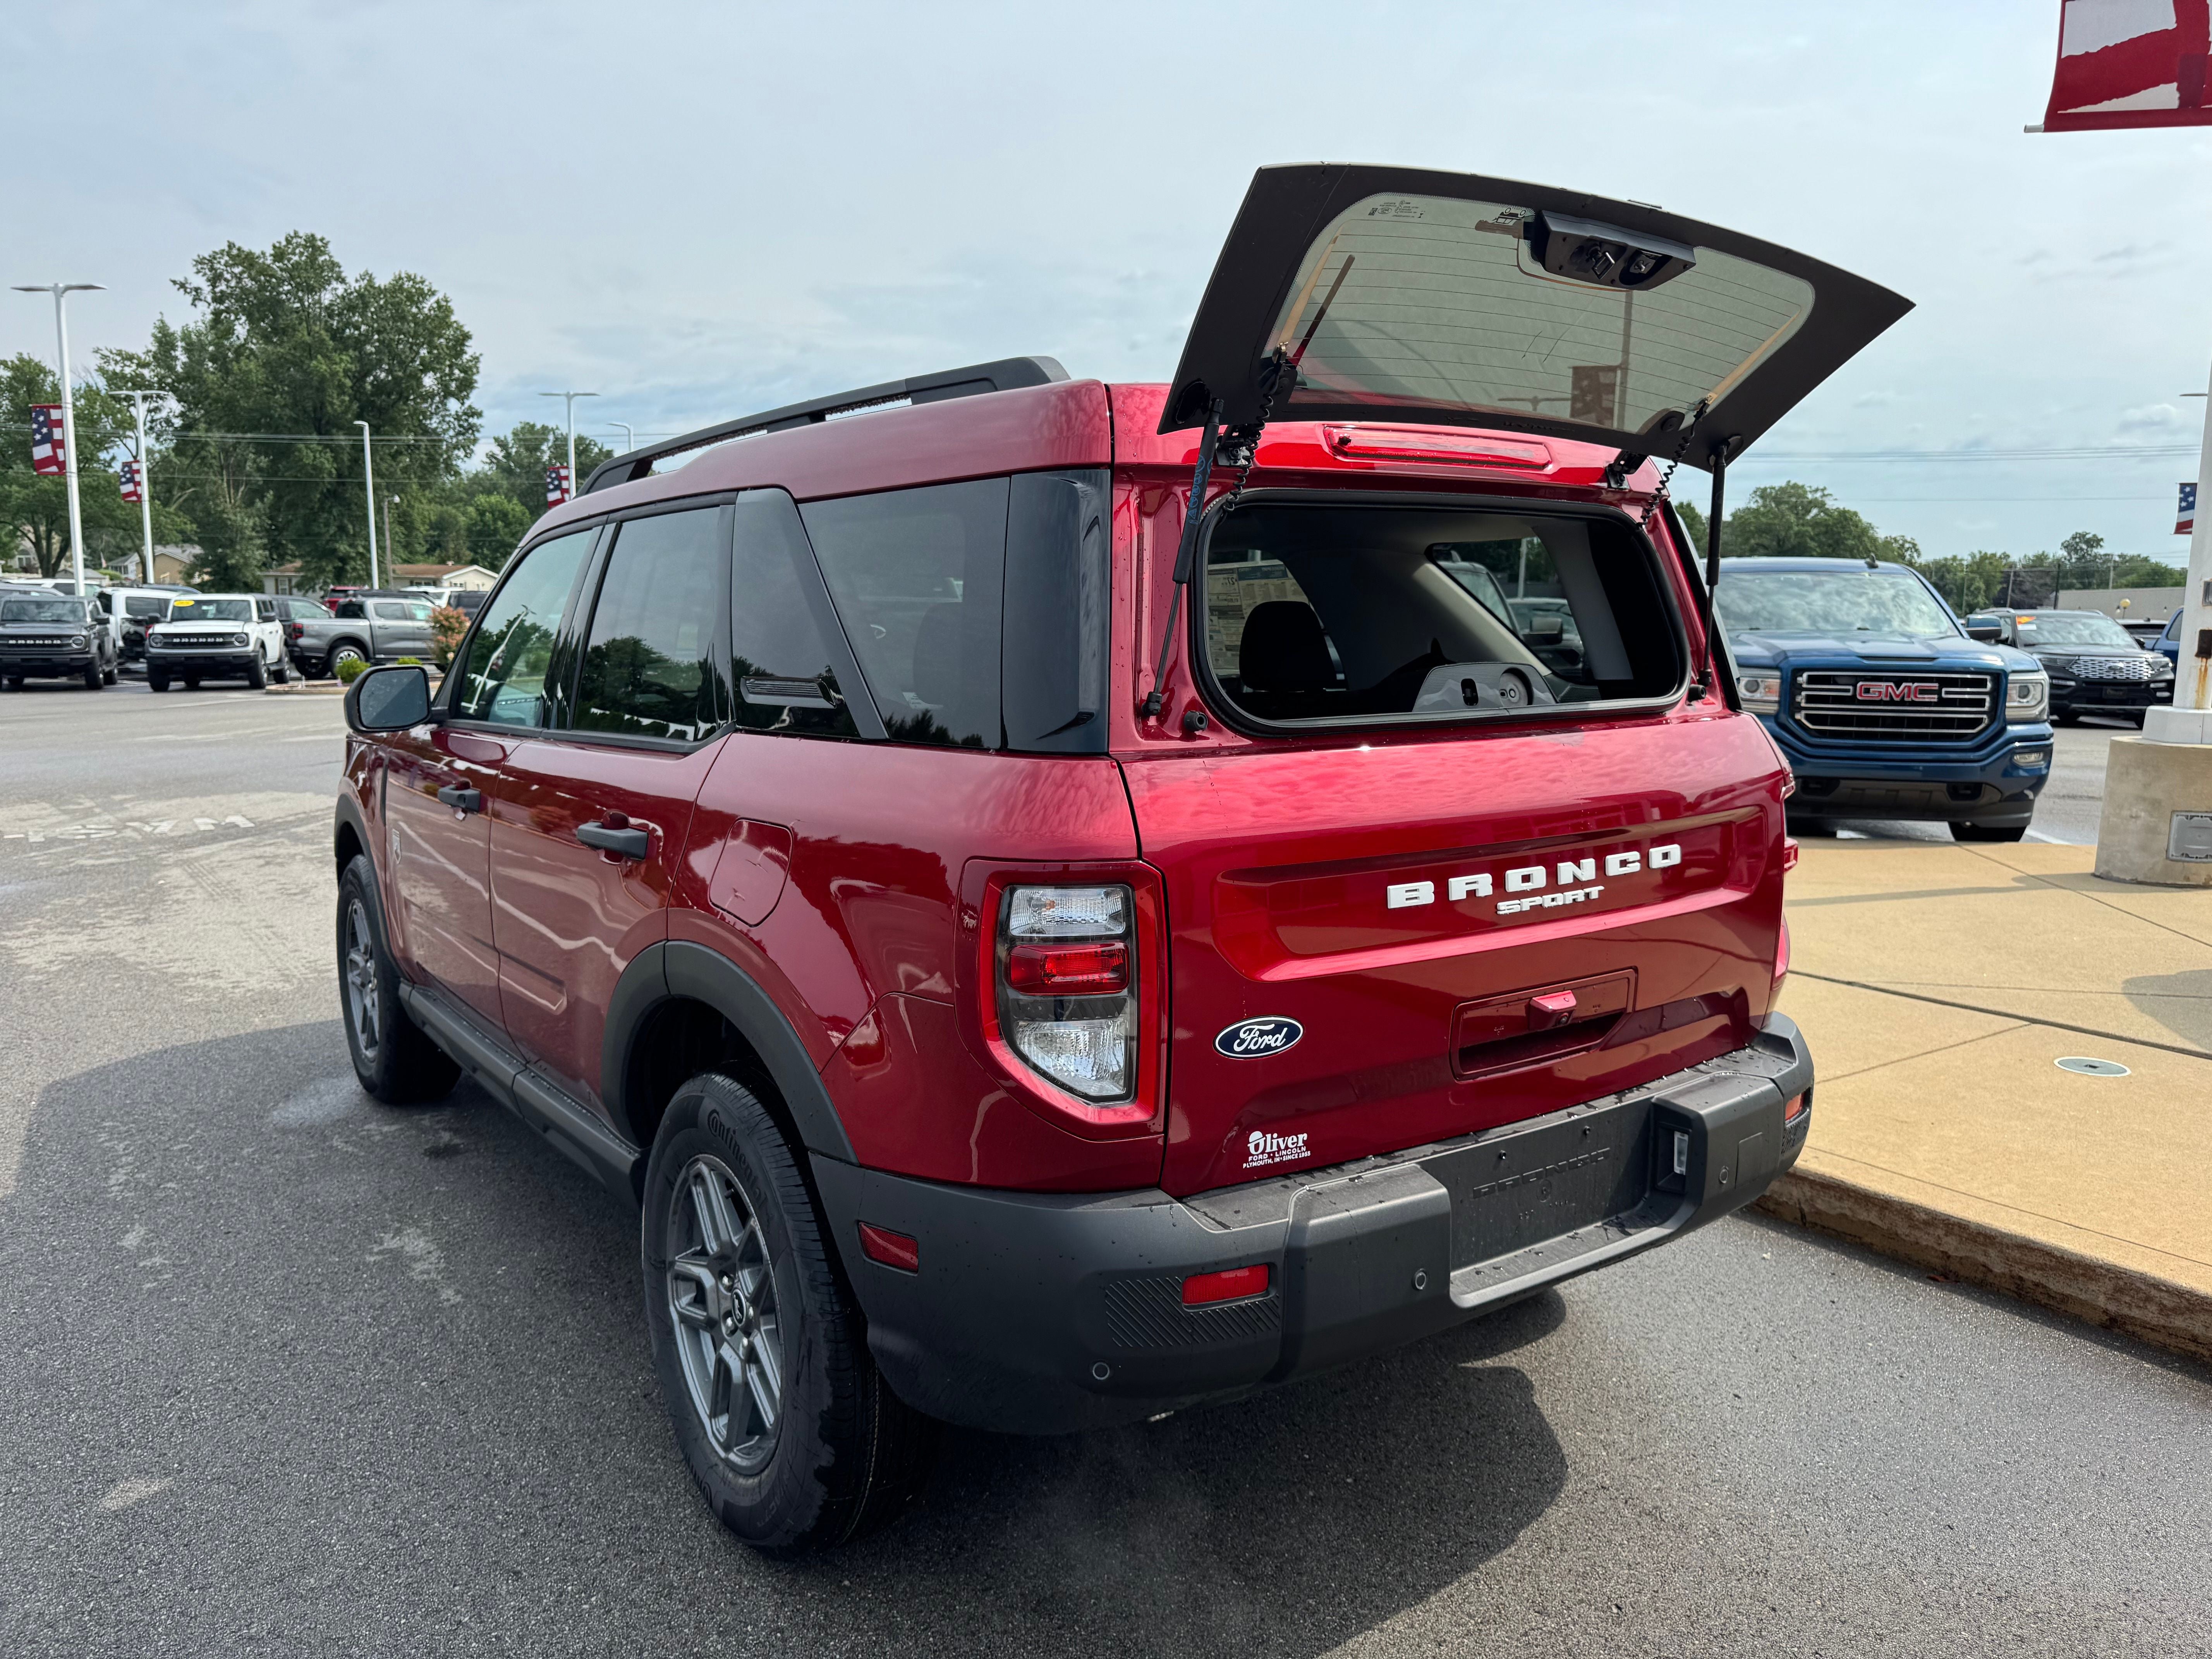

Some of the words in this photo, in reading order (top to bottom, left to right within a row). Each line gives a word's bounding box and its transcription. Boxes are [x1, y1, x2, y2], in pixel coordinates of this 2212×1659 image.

[1856, 682, 1939, 702] GMC
[1387, 844, 1681, 909] BRONCO
[1497, 886, 1604, 915] SPORT
[1233, 1024, 1288, 1051] Ford
[1247, 1131, 1307, 1154] Oliver
[1249, 1154, 1268, 1162] FORD
[1275, 1146, 1306, 1157] LINCOLN
[1243, 1158, 1273, 1169] PLYMOUTH,
